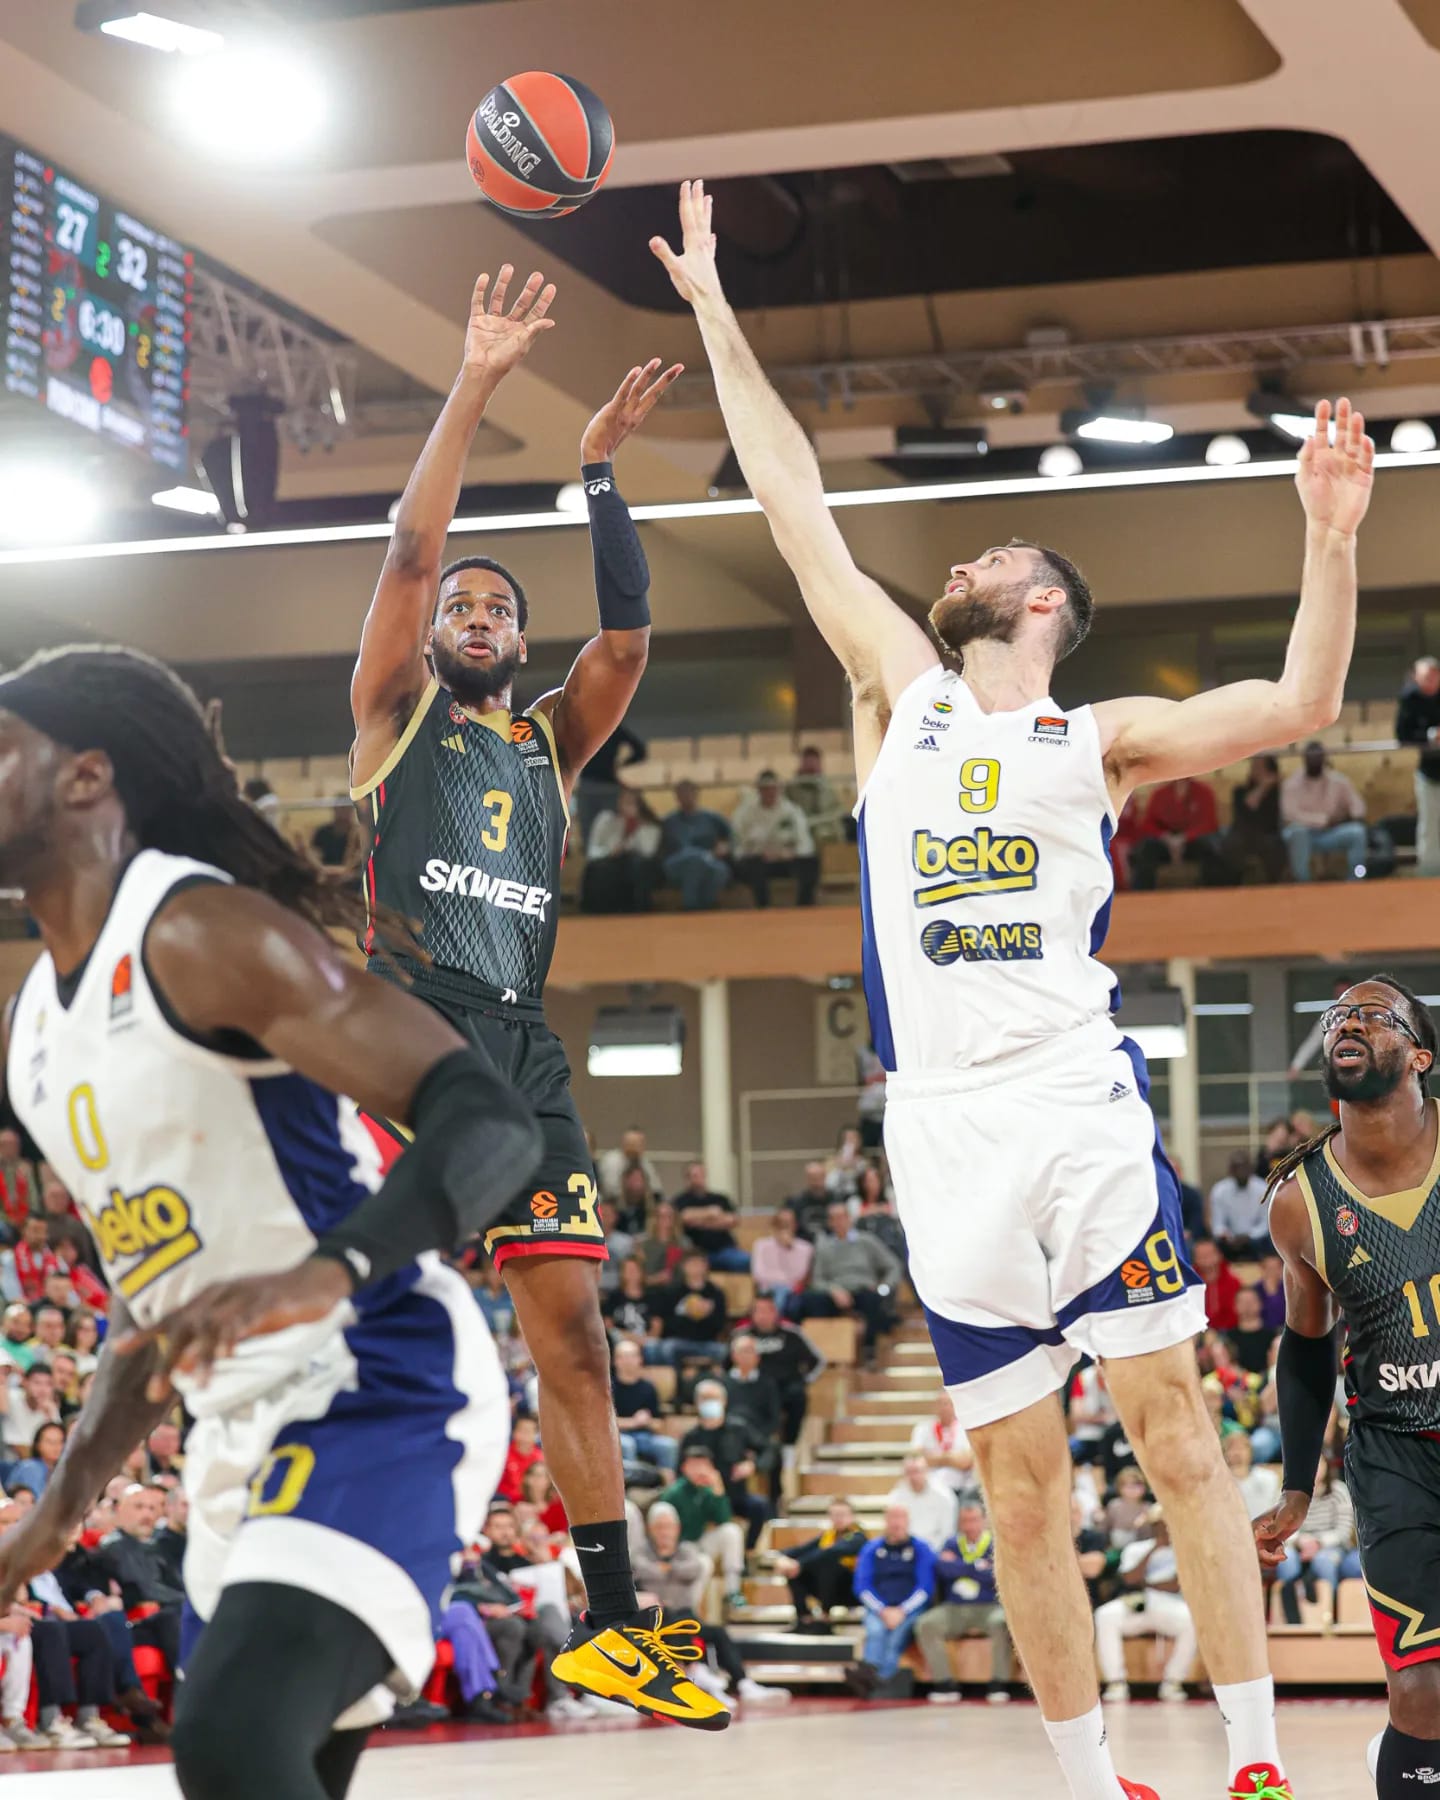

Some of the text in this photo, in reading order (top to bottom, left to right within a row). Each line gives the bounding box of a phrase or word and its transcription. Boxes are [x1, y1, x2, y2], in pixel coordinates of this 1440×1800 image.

[479, 93, 541, 180] SPALDING
[56, 203, 89, 254] 27
[117, 239, 147, 292] 32
[922, 715, 950, 729] beko
[1027, 735, 1070, 747] oneteam
[959, 758, 1001, 814] 9
[481, 790, 513, 853] 3
[913, 827, 1039, 878] beko
[960, 925, 1040, 950] RAMS
[965, 949, 1041, 959] GLOBAL
[827, 996, 858, 1039] C
[68, 1082, 110, 1171] 0
[567, 1173, 597, 1234] 3
[1144, 1230, 1184, 1293] 9
[247, 1444, 316, 1516] 0
